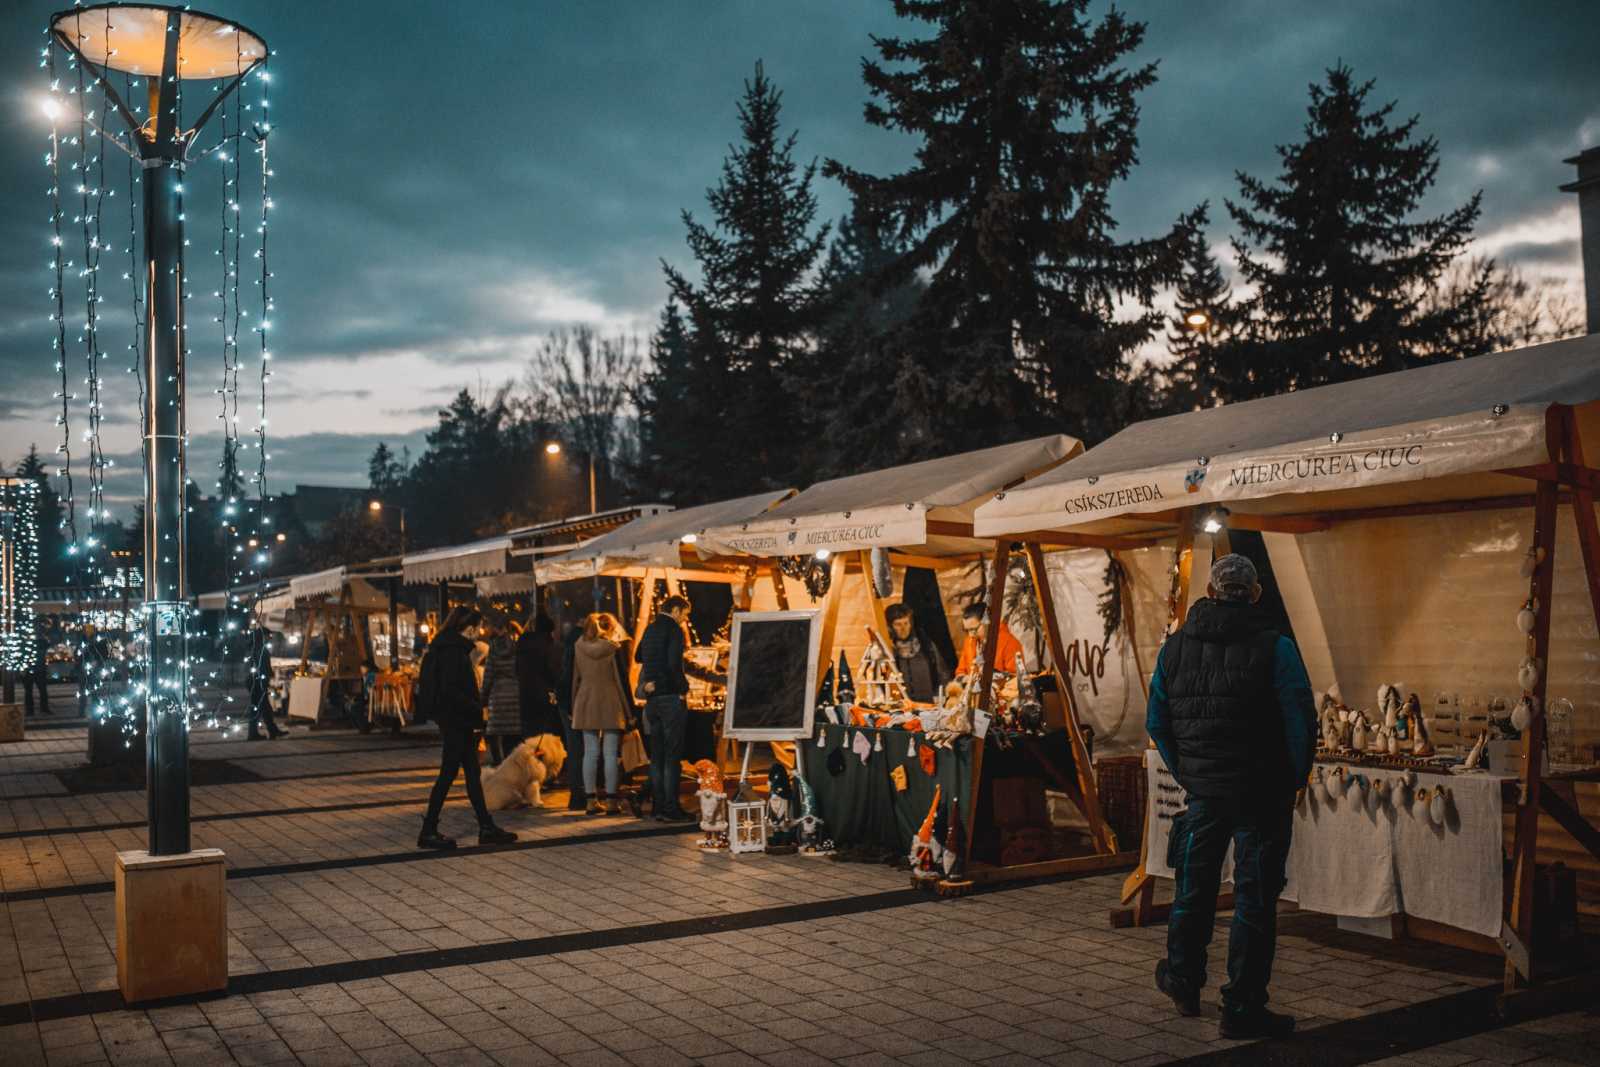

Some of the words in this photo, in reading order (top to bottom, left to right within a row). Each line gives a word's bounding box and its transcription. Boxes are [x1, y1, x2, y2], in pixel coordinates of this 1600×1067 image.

[1229, 454, 1360, 488] MIERCUREA
[1364, 445, 1423, 472] CIUC
[1064, 483, 1164, 515] CSÍKSZEREDA
